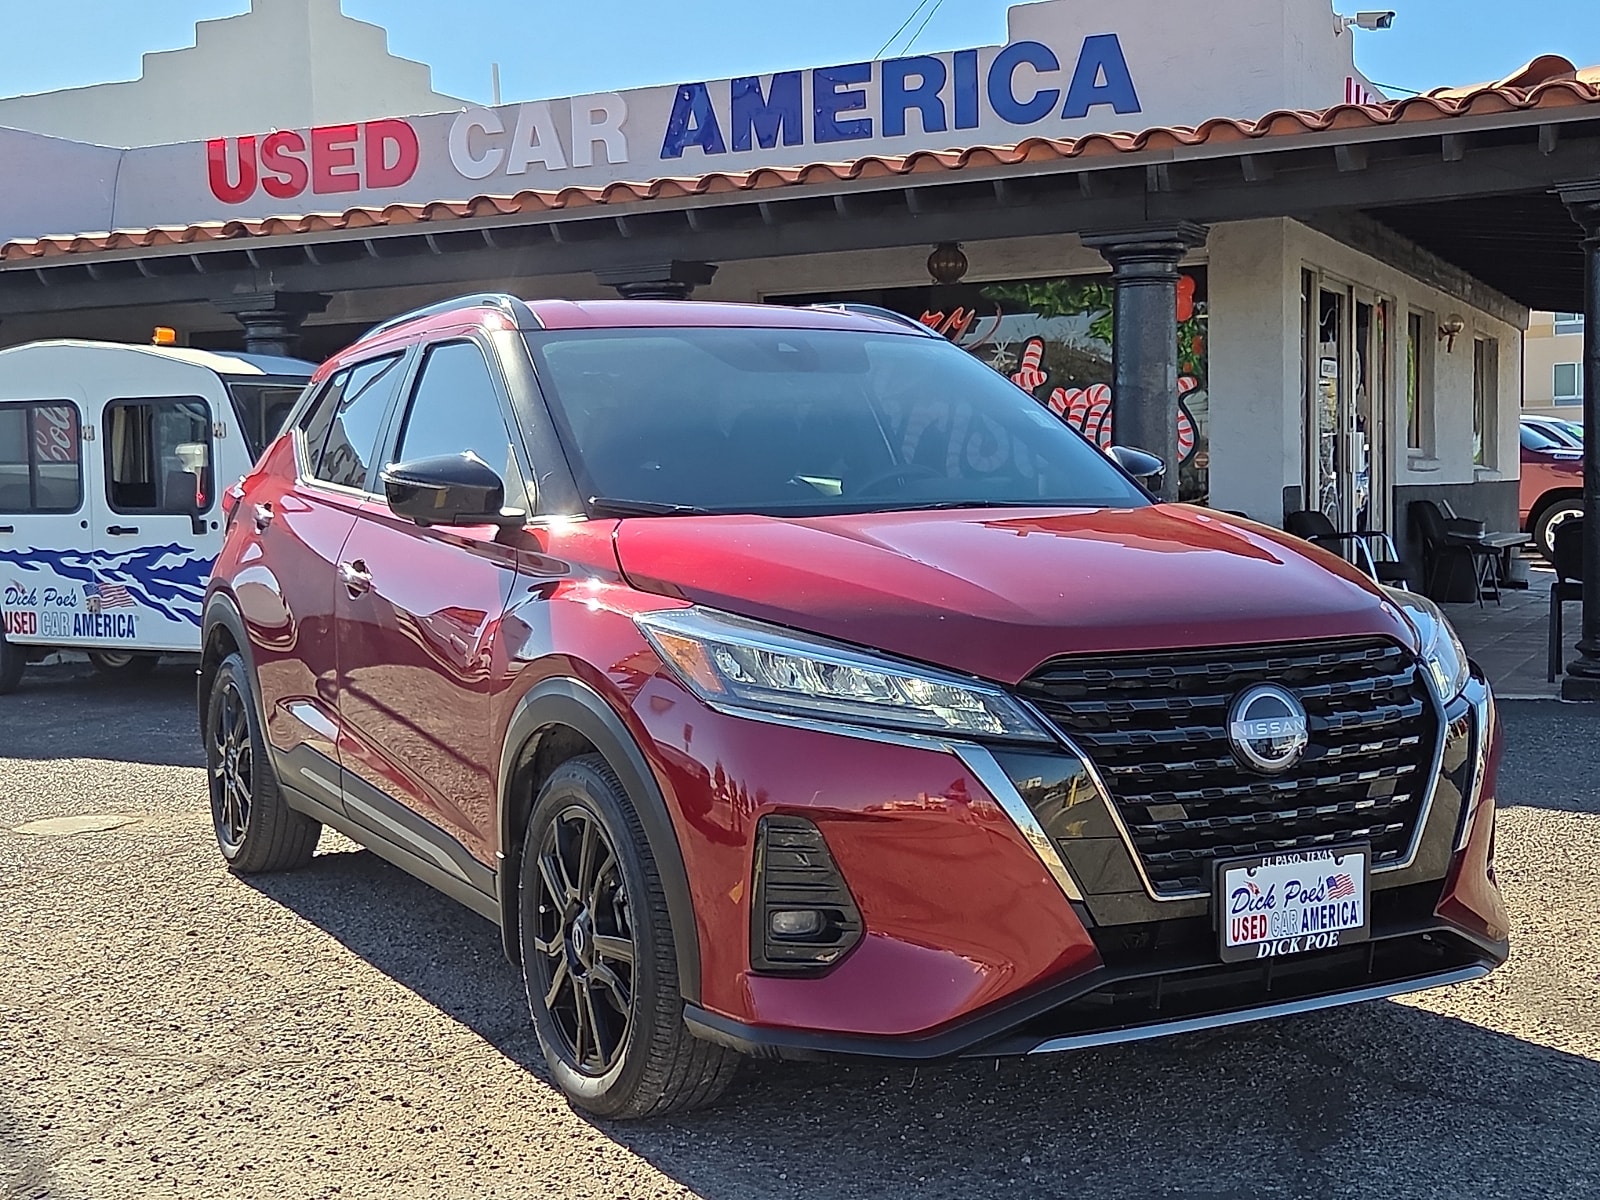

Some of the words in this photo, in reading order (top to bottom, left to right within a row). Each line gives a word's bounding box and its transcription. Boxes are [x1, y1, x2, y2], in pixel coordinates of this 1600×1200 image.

[207, 117, 420, 205] USED
[448, 92, 629, 180] CAR
[660, 33, 1141, 159] AMERICA
[5, 587, 38, 606] Dick
[43, 587, 78, 607] Poe's
[5, 611, 37, 635] USED
[41, 611, 70, 637] CAR
[73, 613, 136, 639] AMERICA
[1236, 720, 1305, 736] NISSAN
[1262, 857, 1274, 868] EL
[1306, 849, 1334, 862] TEXAS
[1231, 883, 1277, 915] Dick
[1284, 875, 1326, 908] Poe's
[1232, 914, 1267, 942] USED
[1270, 909, 1298, 937] CAR
[1301, 900, 1358, 933] AMERICA
[1256, 935, 1303, 959] DICK
[1303, 931, 1340, 951] POE
